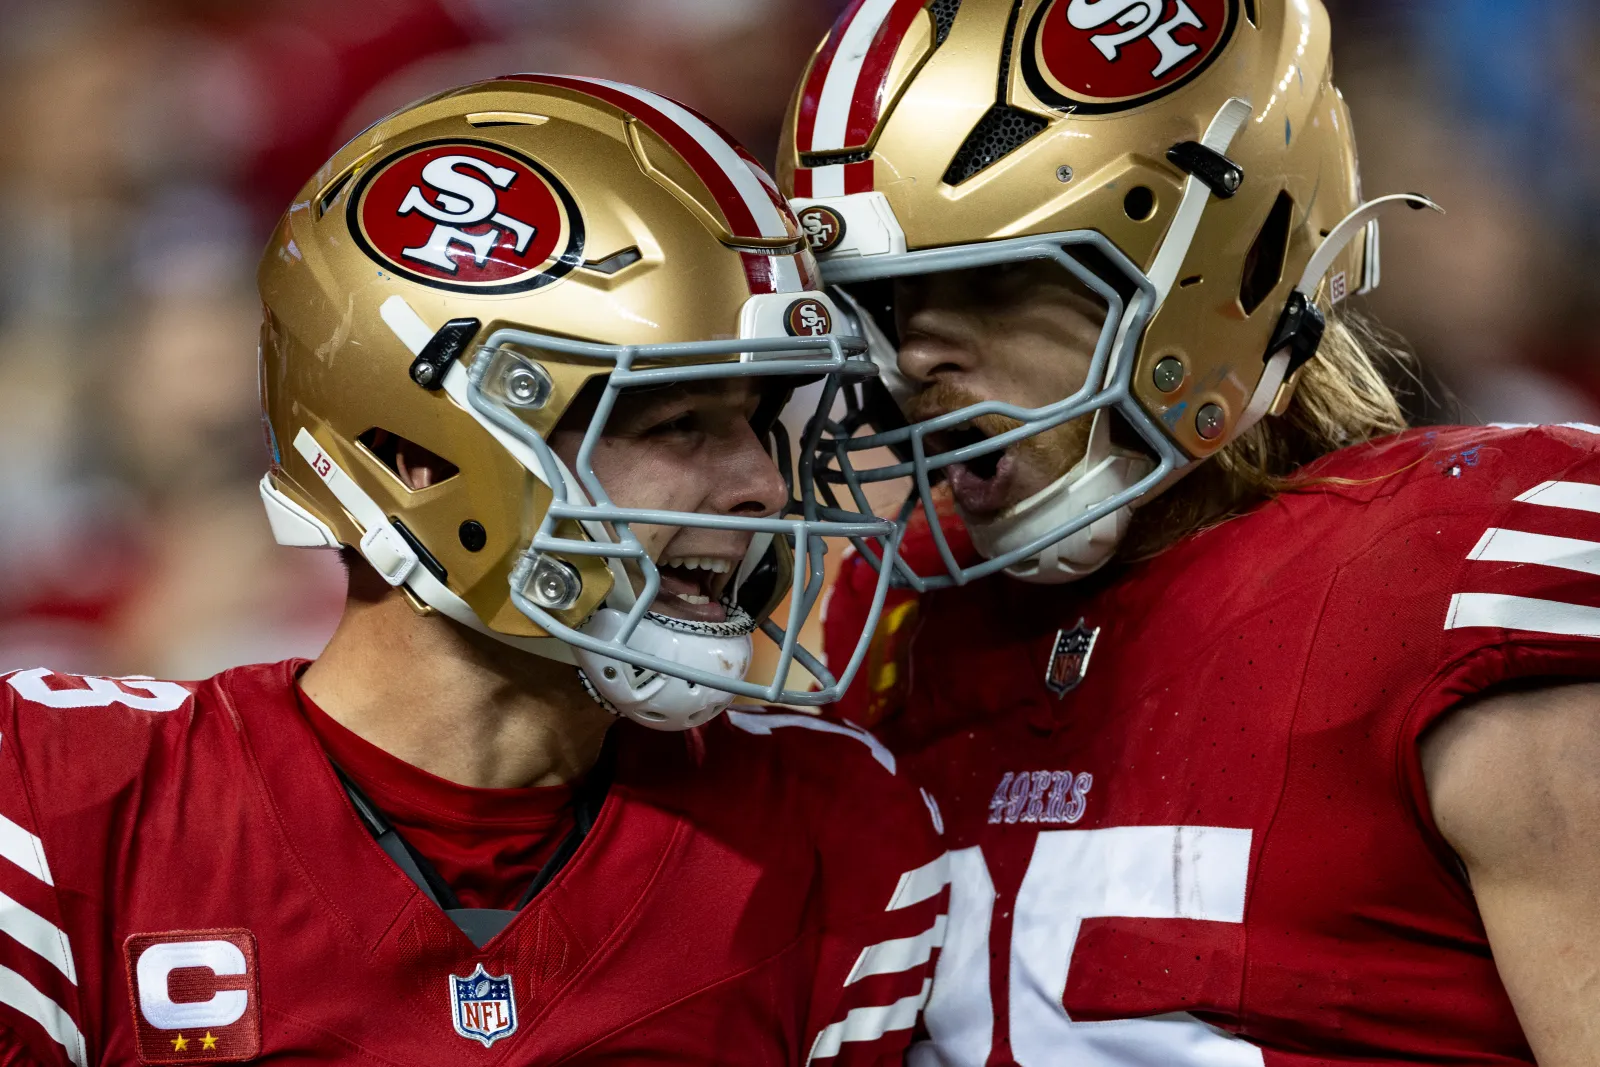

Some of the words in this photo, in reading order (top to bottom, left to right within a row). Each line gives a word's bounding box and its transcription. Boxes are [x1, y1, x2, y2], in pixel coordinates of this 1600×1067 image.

[397, 154, 537, 276] SF
[802, 212, 833, 248] SF
[1332, 275, 1345, 300] 85
[799, 304, 827, 337] SF
[311, 451, 332, 478] 13
[987, 769, 1094, 825] 49ERS
[136, 939, 249, 1030] C
[463, 1001, 509, 1031] NFL
